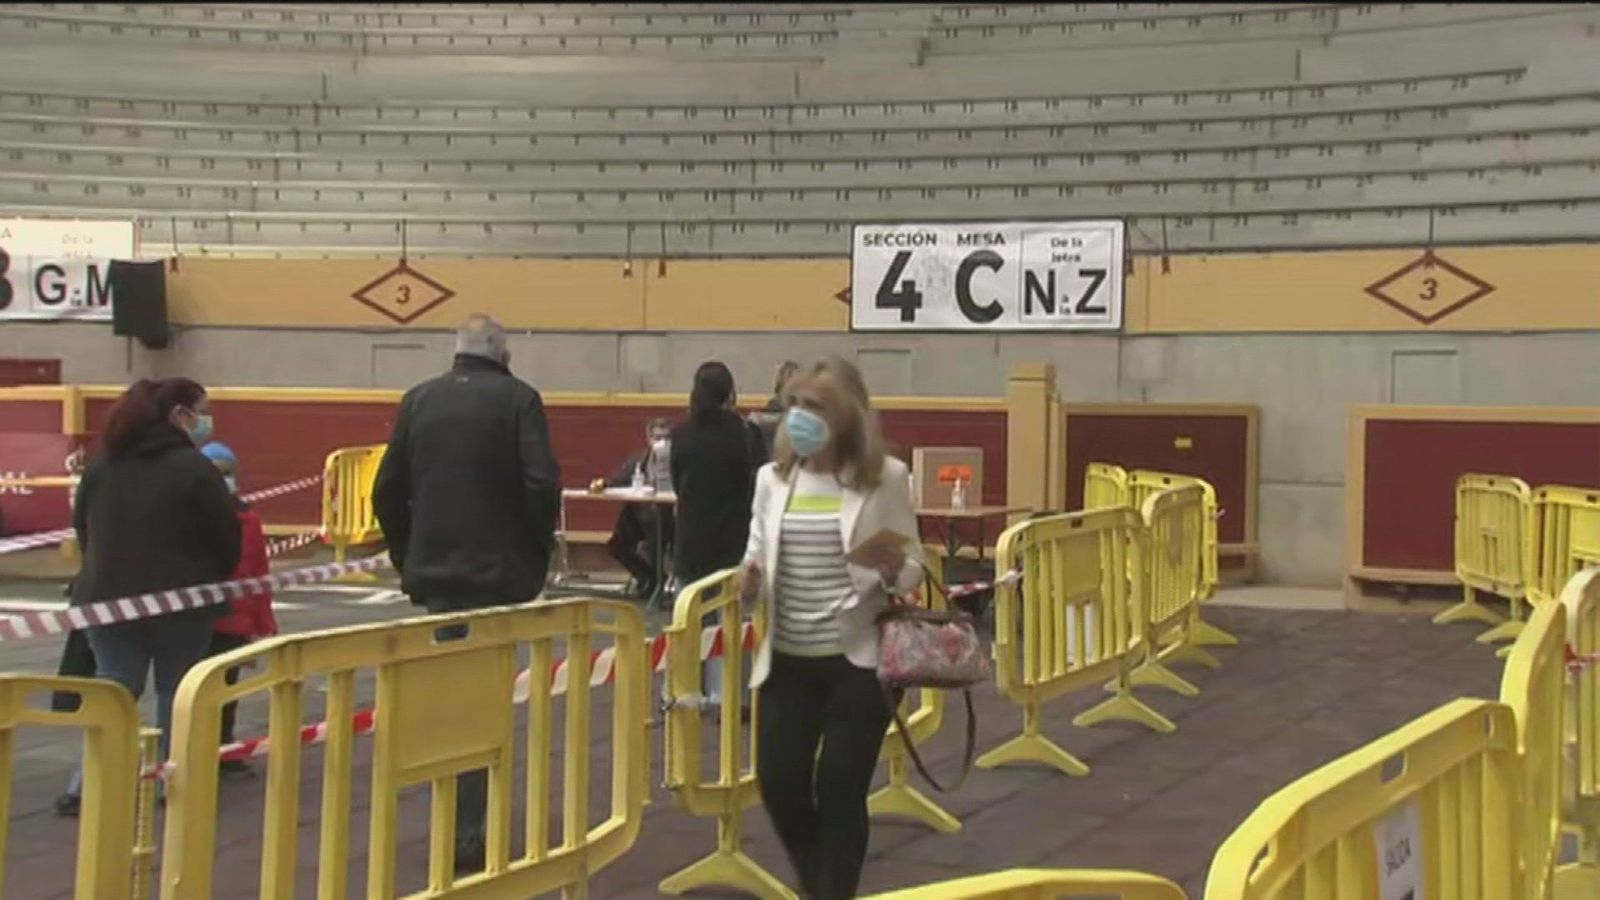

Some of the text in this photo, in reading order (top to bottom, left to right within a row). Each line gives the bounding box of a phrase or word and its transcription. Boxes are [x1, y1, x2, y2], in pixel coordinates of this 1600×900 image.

[863, 231, 1005, 247] SECCIÓN MESA
[1051, 237, 1069, 247] De
[35, 264, 67, 305] G
[396, 285, 411, 304] 3
[875, 250, 1005, 324] 4 C
[1024, 269, 1056, 315] N
[1074, 268, 1108, 315] Z
[1419, 278, 1438, 301] 3
